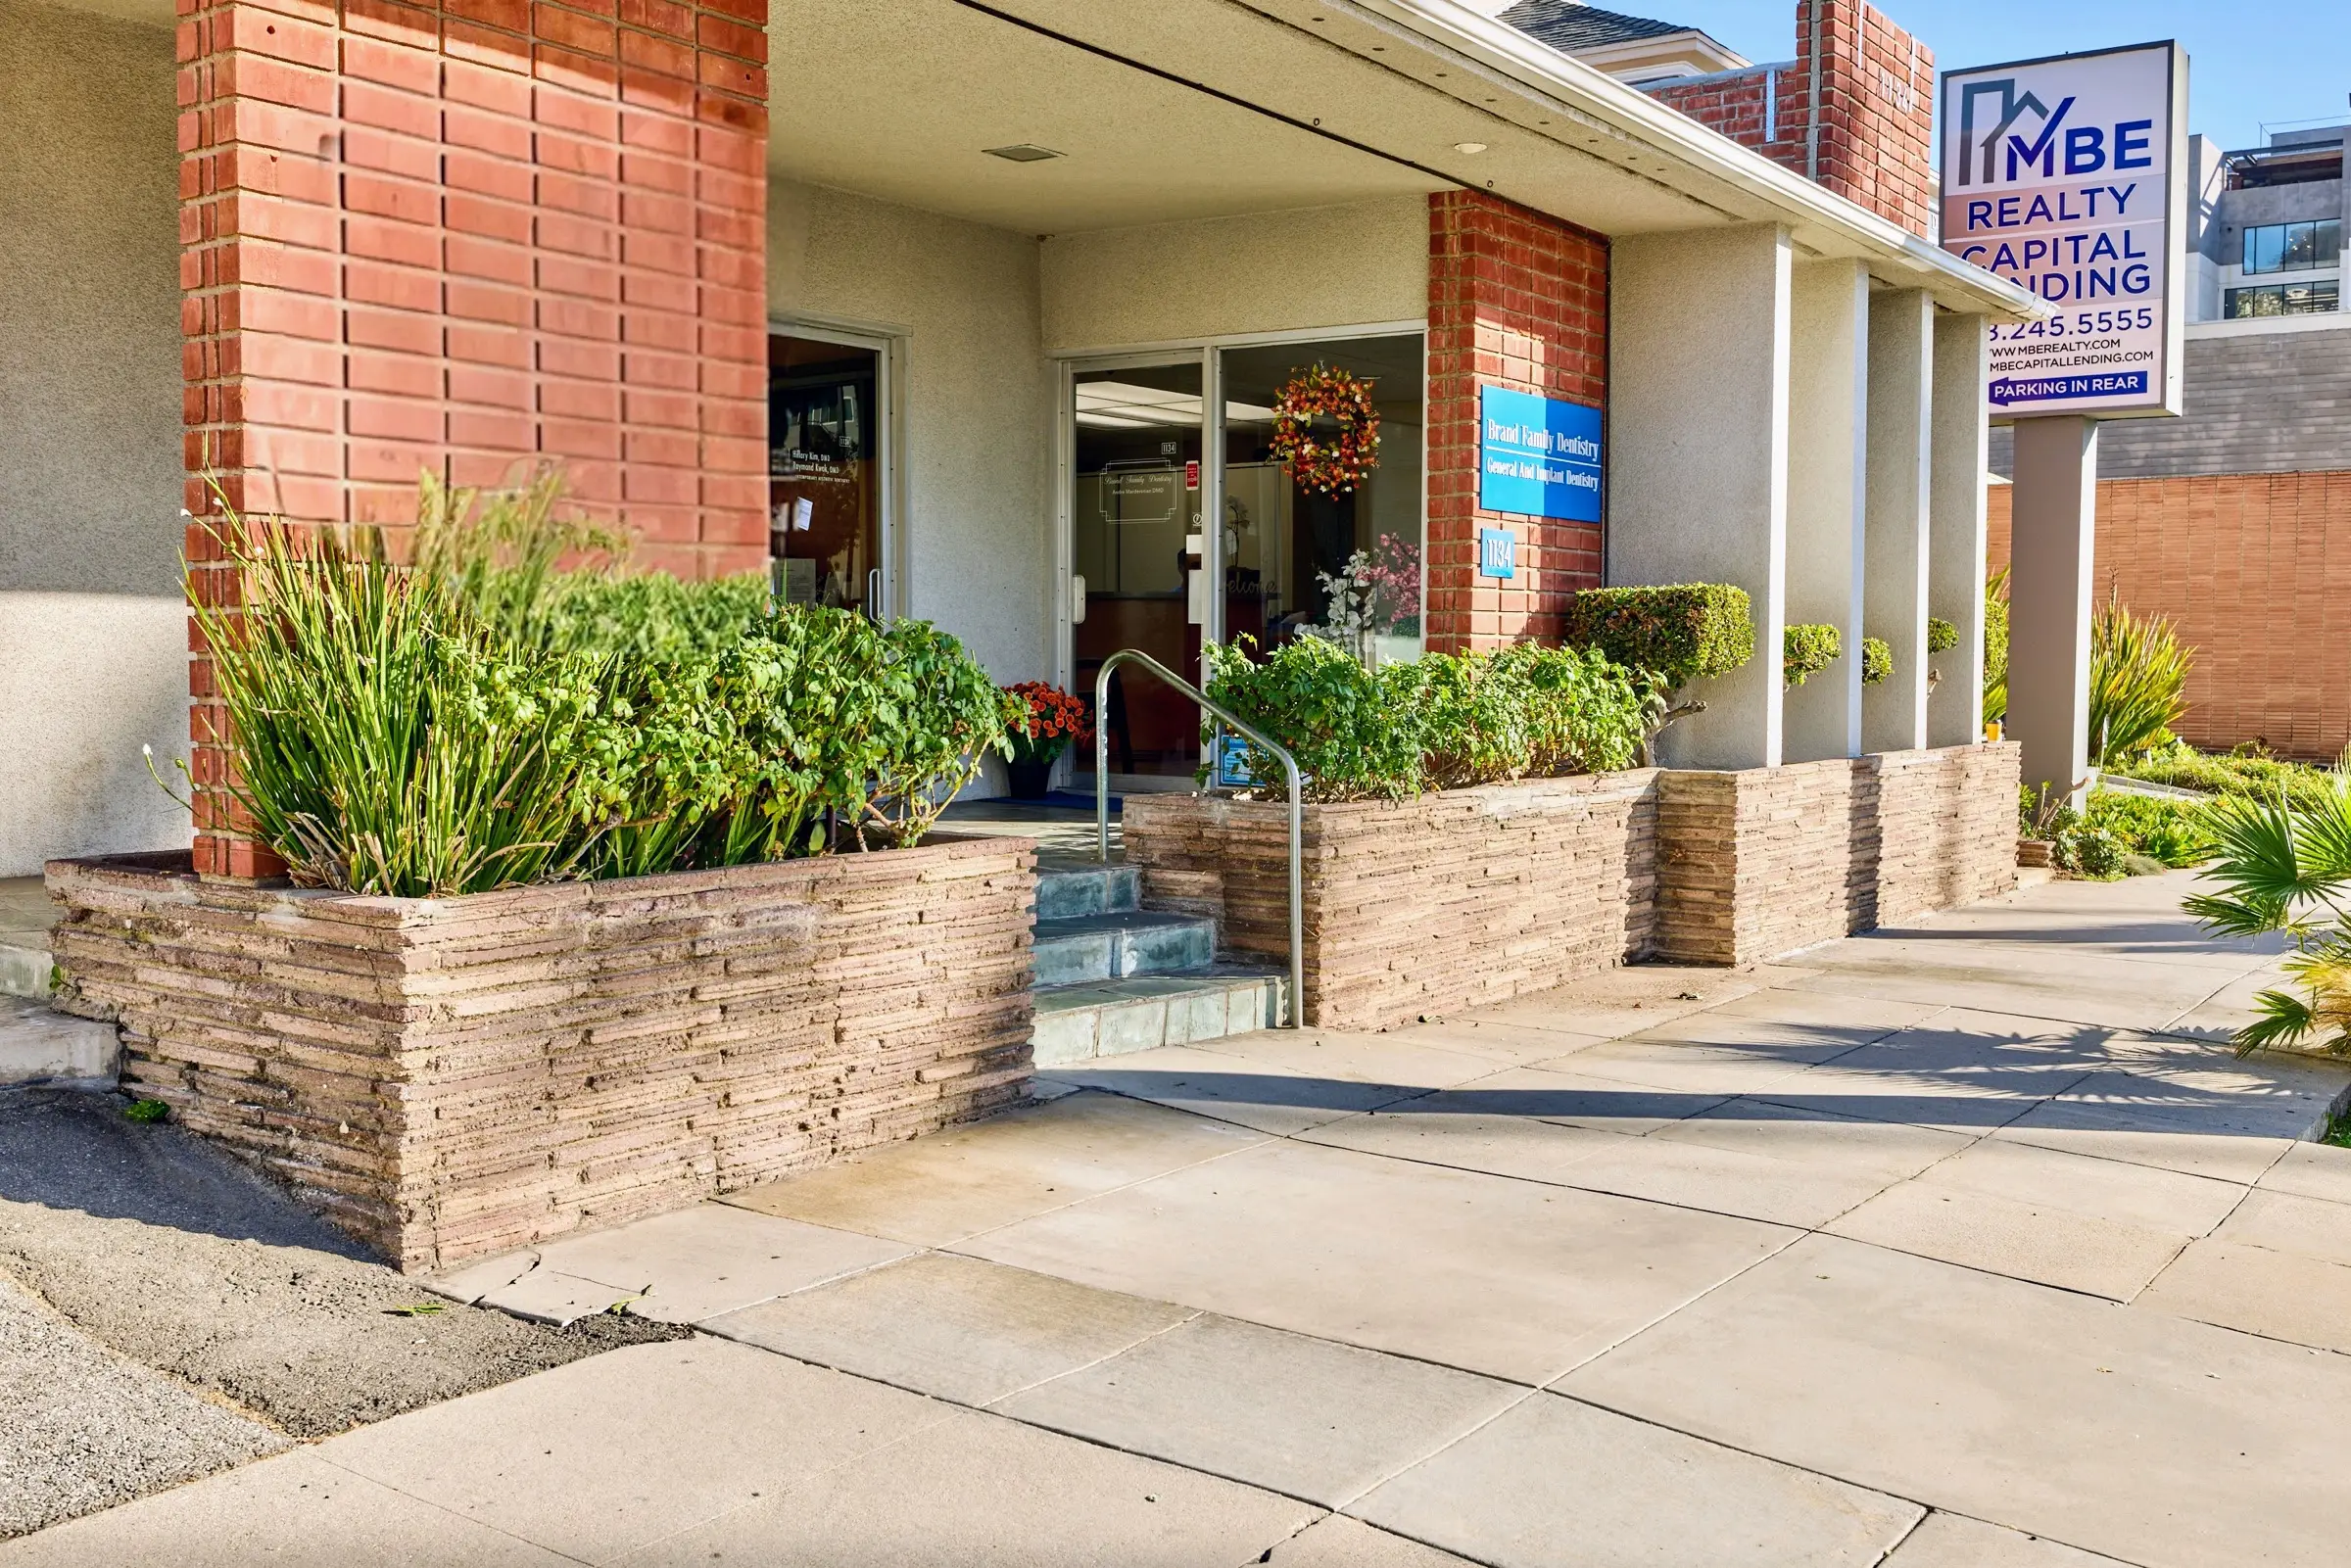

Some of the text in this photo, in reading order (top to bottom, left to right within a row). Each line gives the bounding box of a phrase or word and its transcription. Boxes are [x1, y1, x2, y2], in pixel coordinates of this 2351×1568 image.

[1880, 71, 1913, 114] 1134
[2006, 97, 2152, 181] MBE
[1967, 183, 2137, 231] REALTY
[1960, 229, 2146, 272] CAPITAL
[1994, 376, 2138, 398] PARKING IN REAR
[1163, 444, 1175, 452] 1134
[1487, 418, 1600, 462] Brand Family Dentistry
[1487, 456, 1600, 493] General And Implant Dentistry
[1486, 539, 1511, 567] 1134
